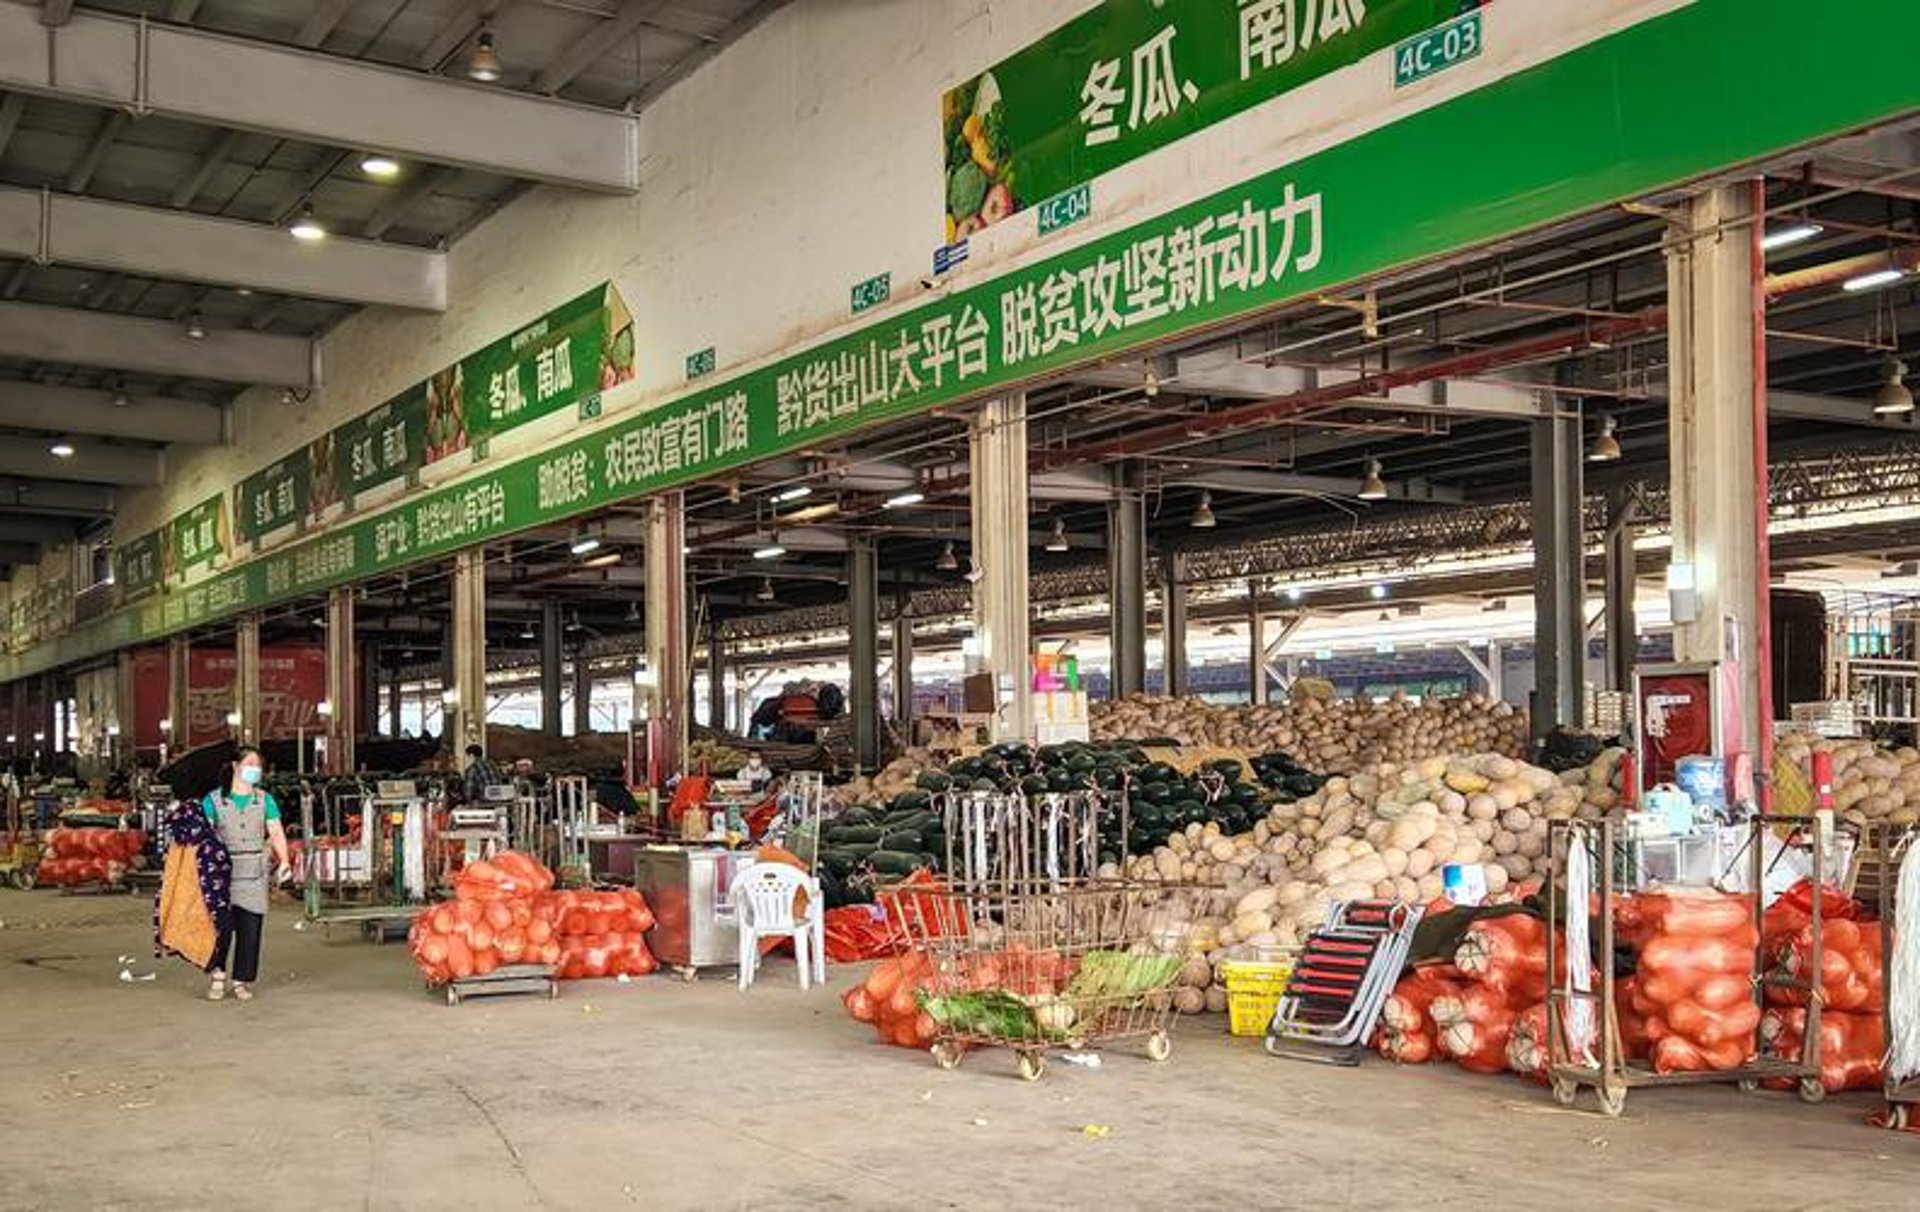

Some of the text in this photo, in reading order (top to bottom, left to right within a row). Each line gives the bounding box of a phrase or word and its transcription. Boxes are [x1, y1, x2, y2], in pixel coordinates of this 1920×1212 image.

[1399, 21, 1476, 77] 4C-03
[1041, 189, 1087, 229] 4C-04
[777, 304, 990, 436] 黔货出山大平台
[1001, 182, 1323, 366] 脱贫攻坚新动力
